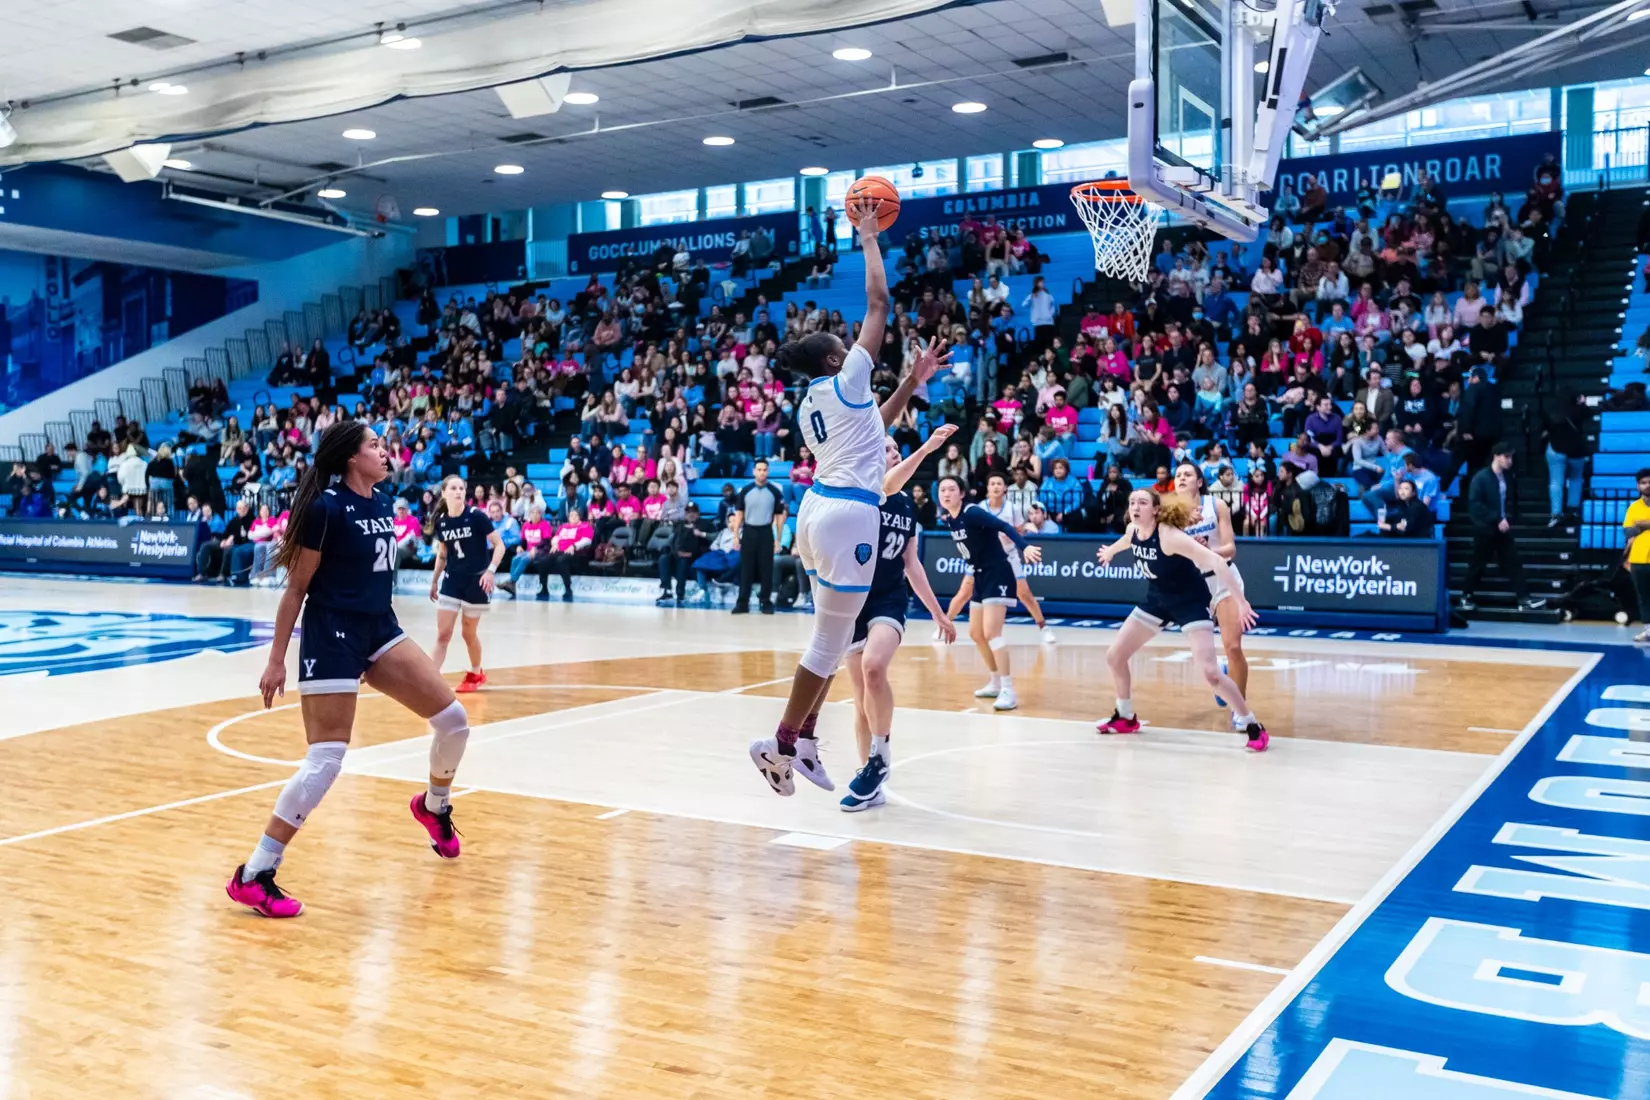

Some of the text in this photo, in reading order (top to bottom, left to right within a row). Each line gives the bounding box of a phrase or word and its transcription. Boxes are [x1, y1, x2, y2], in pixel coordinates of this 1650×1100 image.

[943, 191, 1040, 214] COLUMBIA
[810, 410, 828, 444] 0
[881, 511, 912, 531] YALE
[44, 534, 53, 547] of
[53, 534, 84, 548] Columbia
[441, 526, 472, 542] YALE
[138, 542, 188, 559] Presbyterian
[373, 536, 397, 572] 20
[453, 540, 465, 559] 1
[882, 531, 905, 560] 22
[1131, 543, 1157, 560] YALE
[1063, 561, 1079, 576] of
[1295, 555, 1390, 575] NewYork-
[999, 585, 1008, 596] Y
[1294, 575, 1417, 598] Presbyterian
[303, 659, 316, 677] Y
